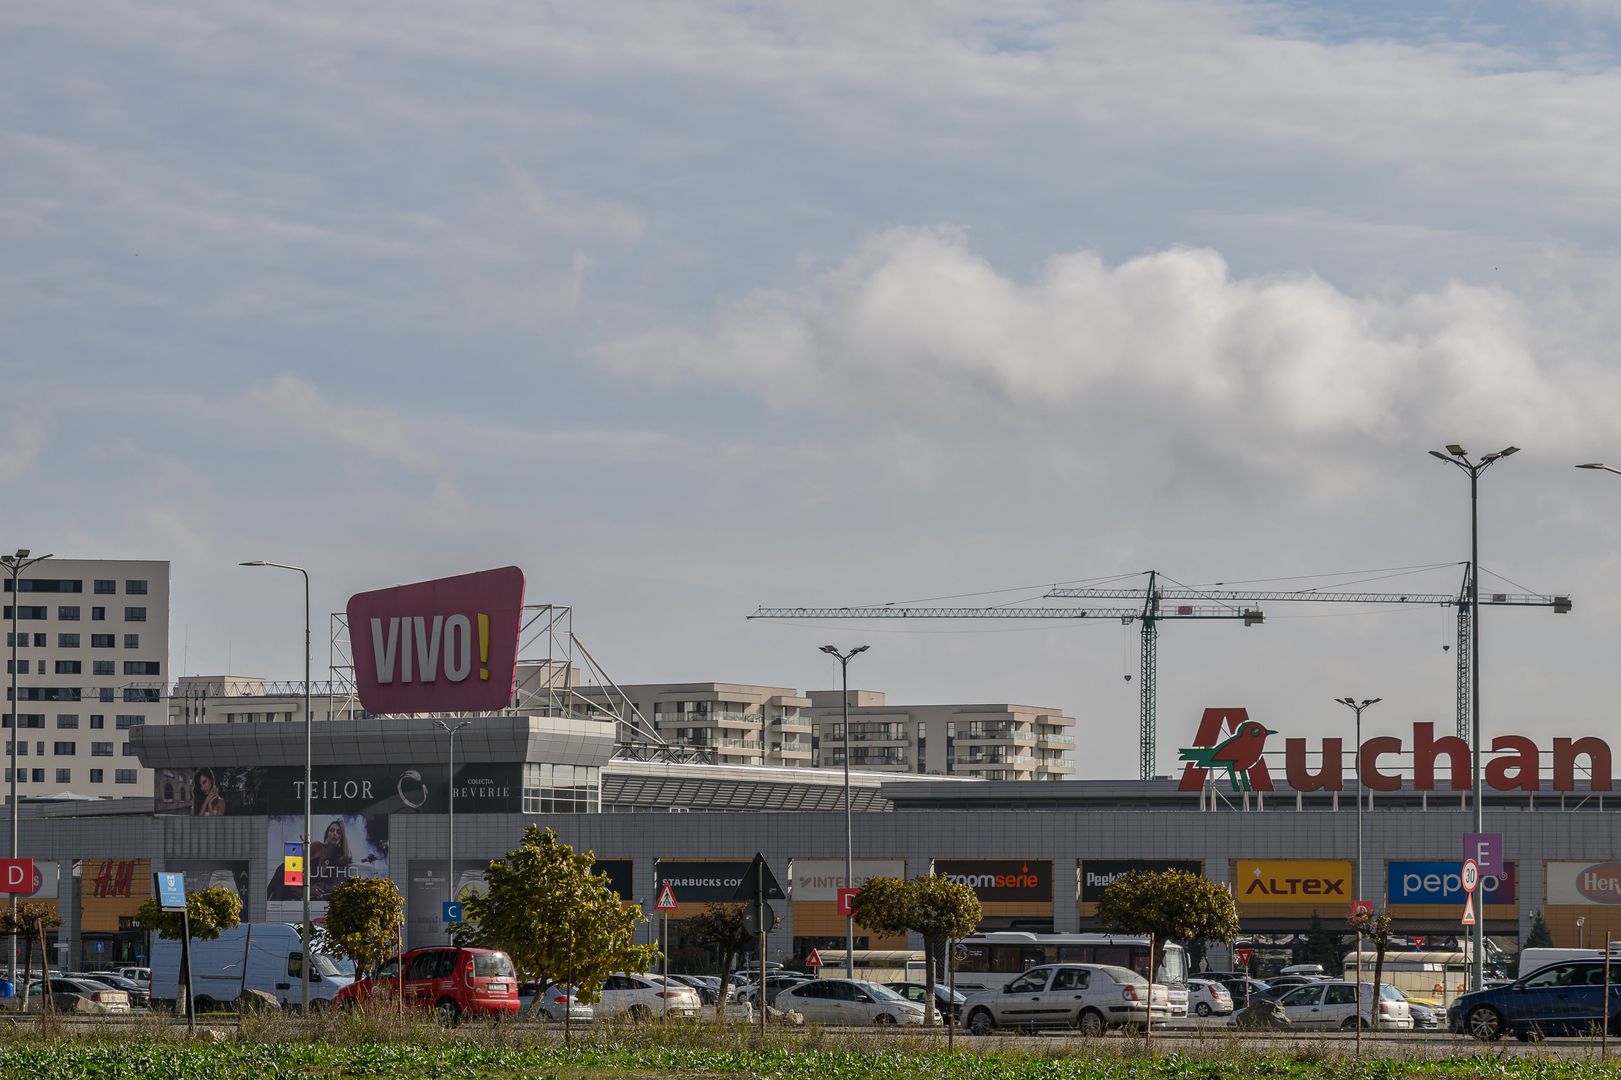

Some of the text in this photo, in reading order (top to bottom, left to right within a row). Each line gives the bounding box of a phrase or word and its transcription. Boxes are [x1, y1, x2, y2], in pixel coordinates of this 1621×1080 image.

[370, 613, 489, 683] VIVO!
[1177, 707, 1612, 792] Auchan
[293, 780, 374, 799] TEILOR
[453, 787, 510, 798] REVERIE
[1477, 842, 1490, 866] E
[8, 865, 24, 885] D
[1403, 873, 1499, 897] pepo
[1465, 868, 1475, 884] 30
[448, 905, 457, 918] C
